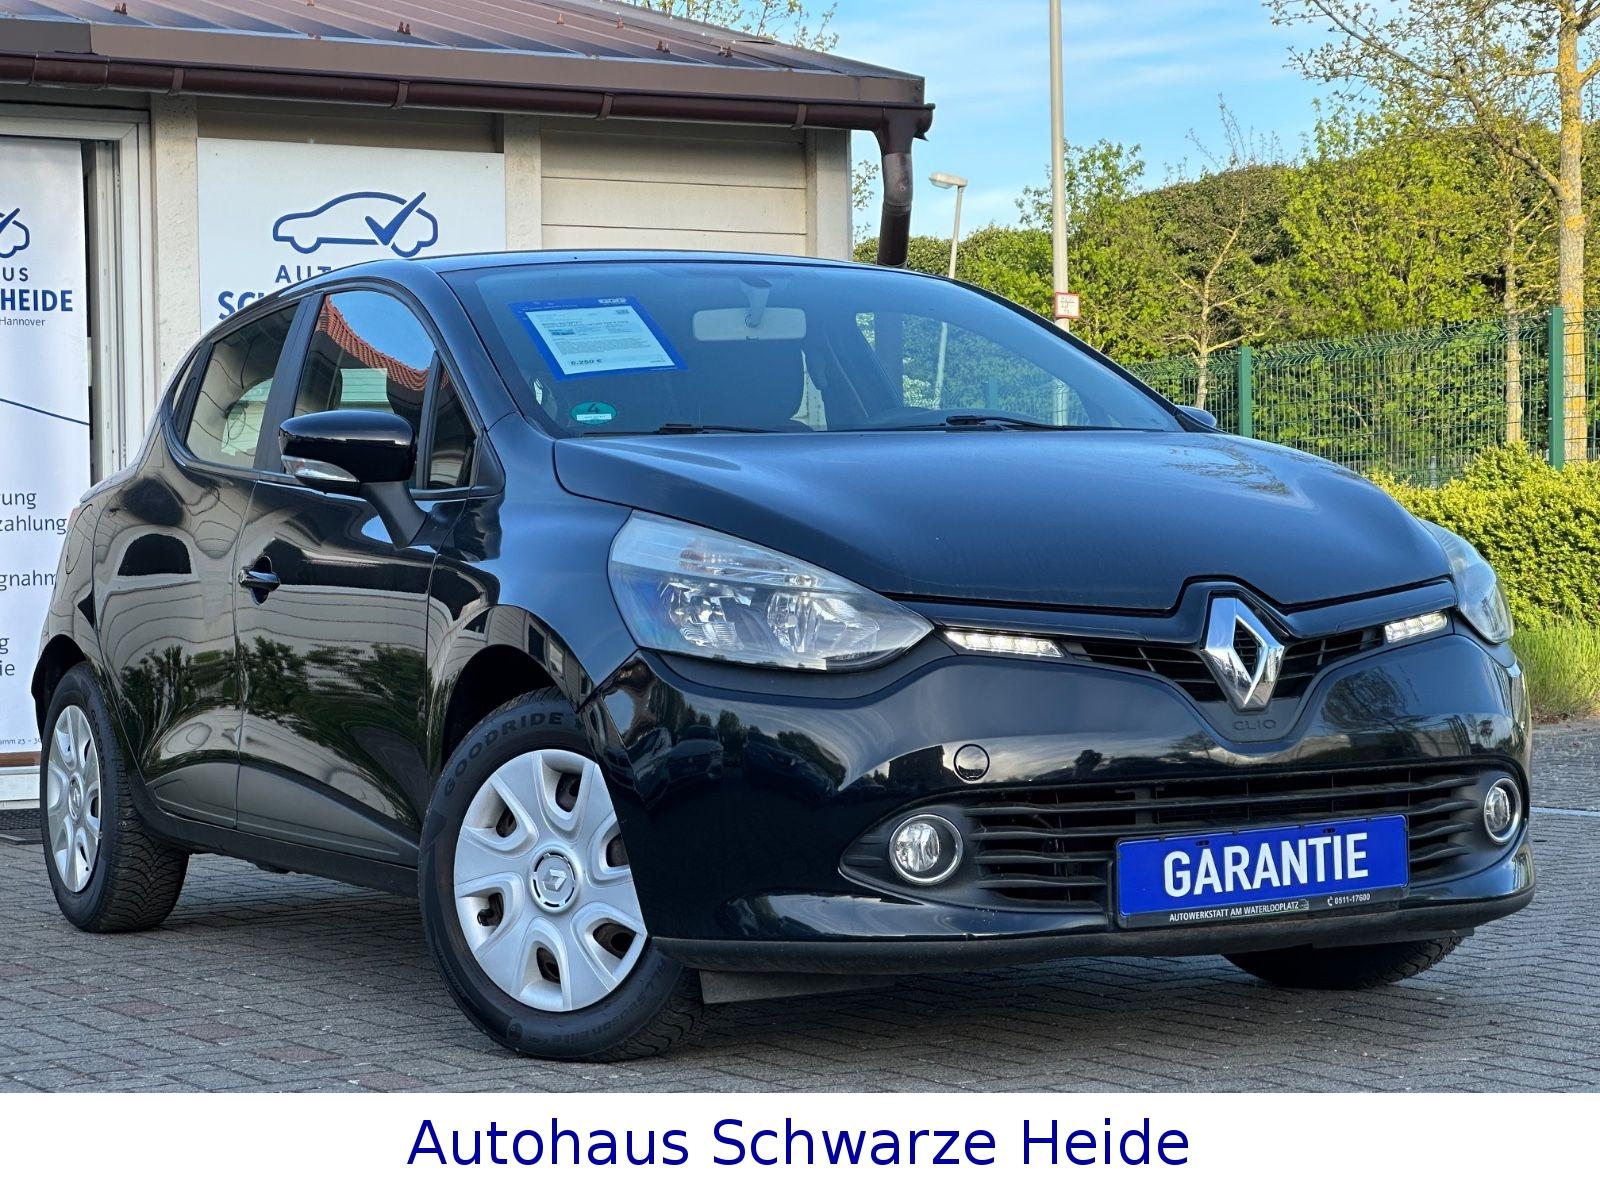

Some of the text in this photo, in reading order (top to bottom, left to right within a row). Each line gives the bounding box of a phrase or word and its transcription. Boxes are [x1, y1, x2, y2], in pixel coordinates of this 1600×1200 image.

[2, 266, 29, 282] US
[0, 289, 73, 312] HEIDE
[0, 316, 46, 326] Hannover
[1233, 719, 1277, 731] CLIO
[444, 711, 564, 797] GOODRIDE
[1163, 832, 1369, 898] GARANTIE
[1169, 892, 1371, 922] AUTOWERKSTATT AM WATERLOOPLATZ 0511-17600
